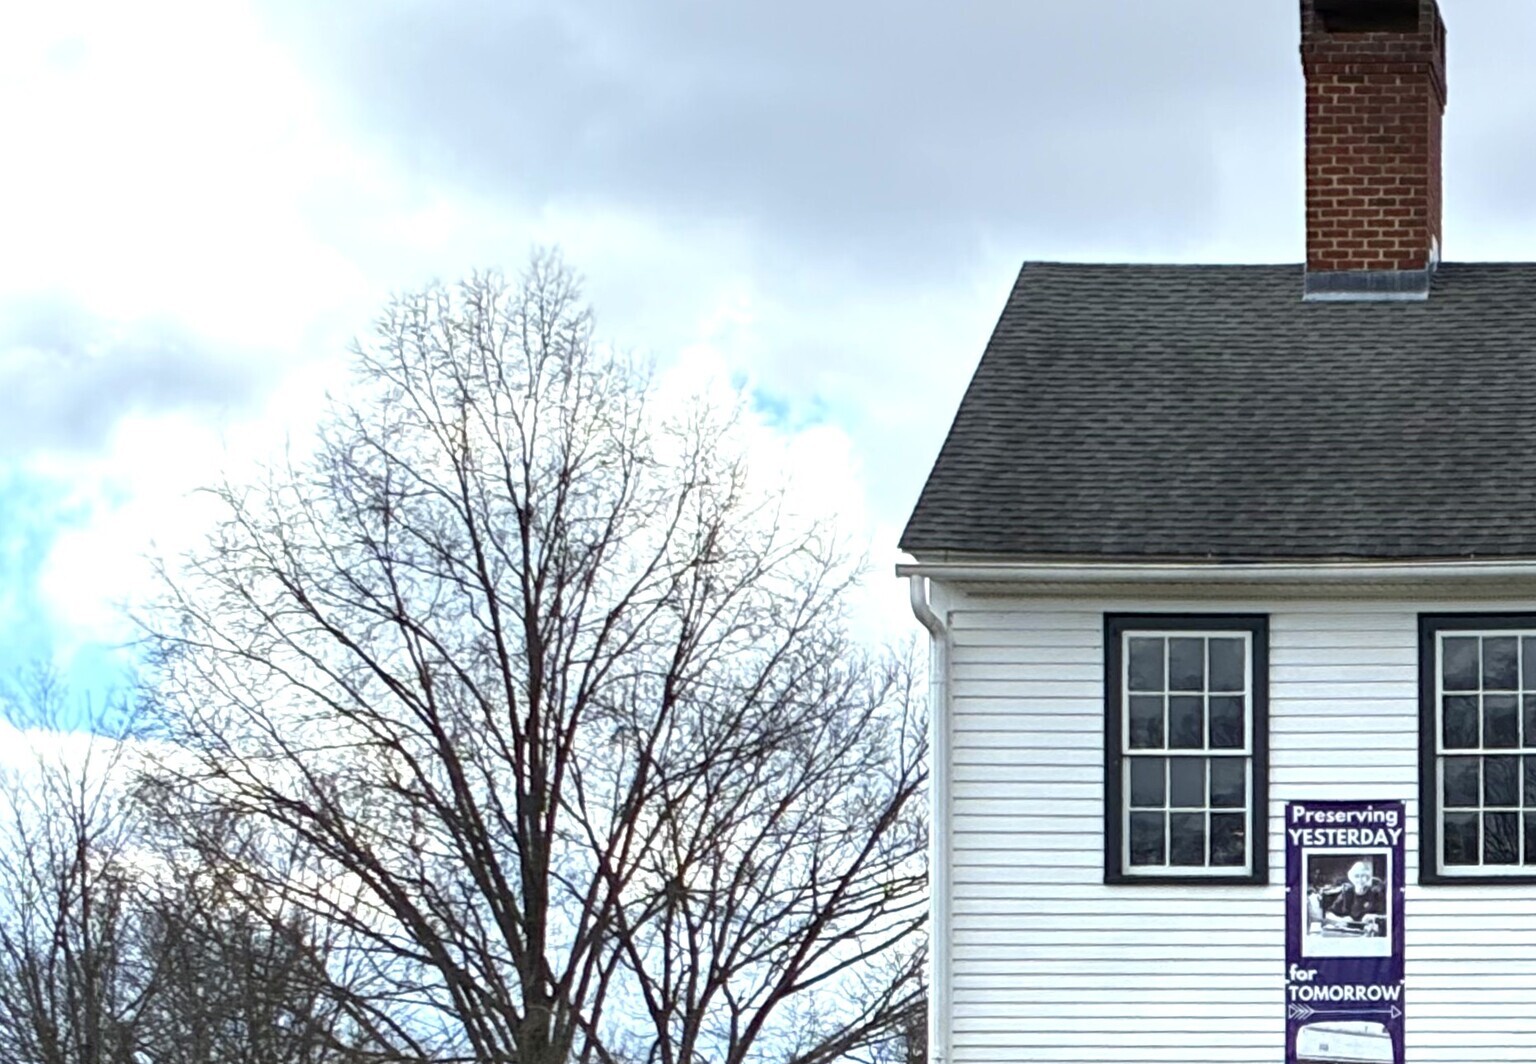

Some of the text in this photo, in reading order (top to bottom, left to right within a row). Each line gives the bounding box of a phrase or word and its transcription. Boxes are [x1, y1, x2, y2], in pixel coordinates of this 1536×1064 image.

[1292, 805, 1398, 827] Preserving
[1288, 828, 1402, 846] YESTERDAY
[1289, 963, 1318, 981] for
[1288, 985, 1401, 1001] TOMORROW
